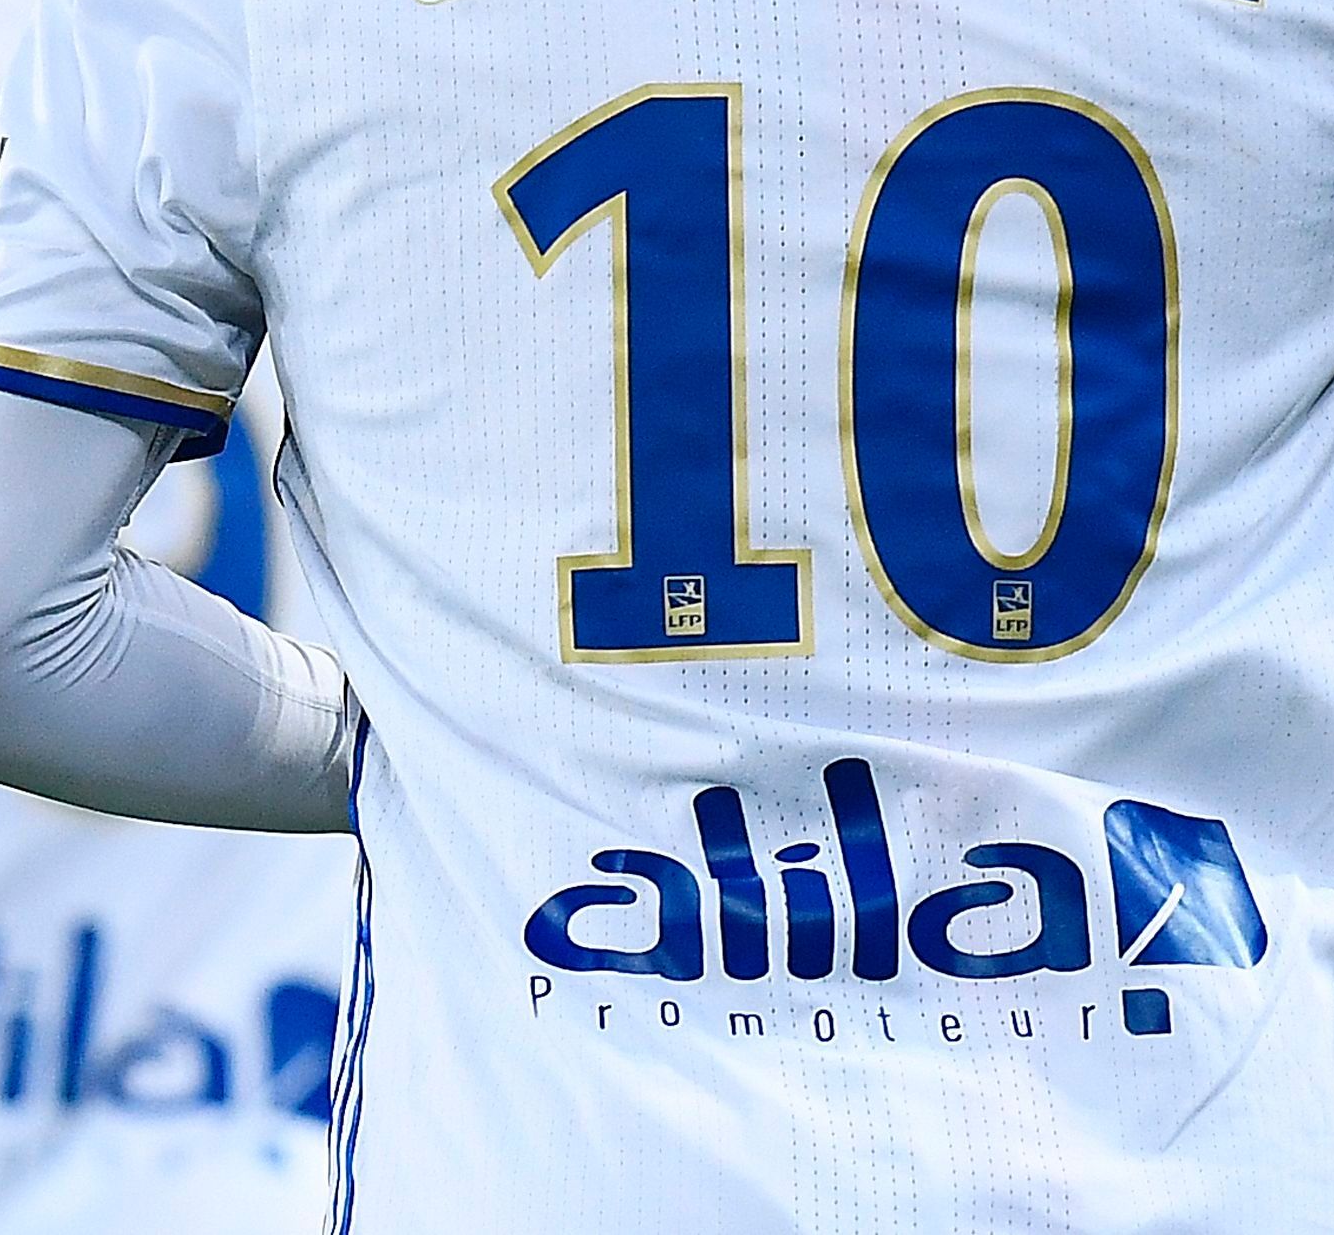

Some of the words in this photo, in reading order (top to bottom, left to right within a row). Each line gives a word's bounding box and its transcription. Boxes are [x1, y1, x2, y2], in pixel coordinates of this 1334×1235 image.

[491, 82, 1181, 665] 10
[668, 614, 702, 628] LFP
[996, 619, 1028, 632] LFP
[529, 975, 1097, 1043] Promoteur
